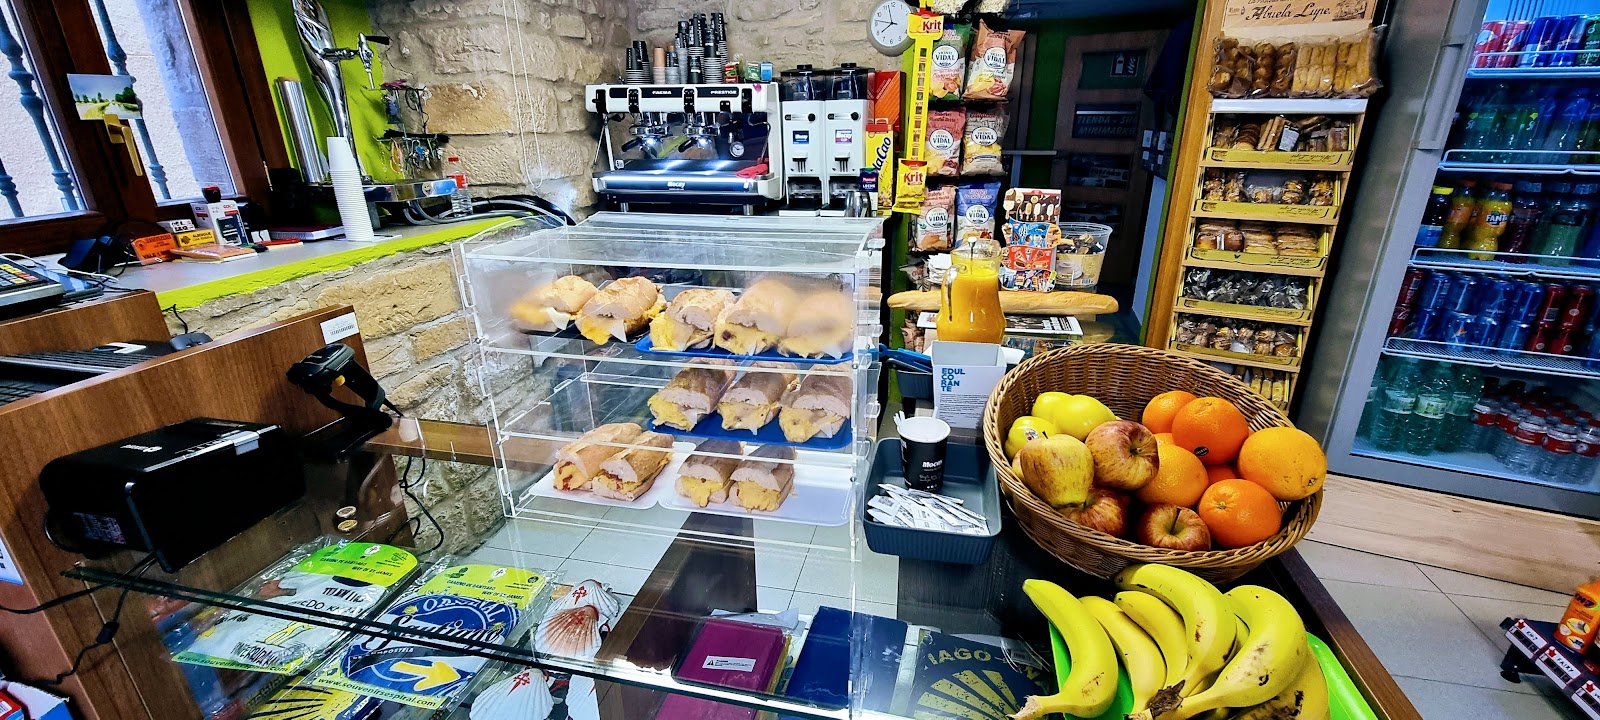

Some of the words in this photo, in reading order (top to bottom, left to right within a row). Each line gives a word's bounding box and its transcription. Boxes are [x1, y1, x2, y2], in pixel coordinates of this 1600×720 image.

[1245, 3, 1292, 20] Abuela
[922, 20, 942, 31] Krit
[987, 55, 1005, 63] VIDAL
[1077, 116, 1110, 124] TIENDA
[903, 172, 923, 183] Krit
[1557, 657, 1574, 673] FAIRY
[318, 678, 437, 707] www.souvenirsespiral.com
